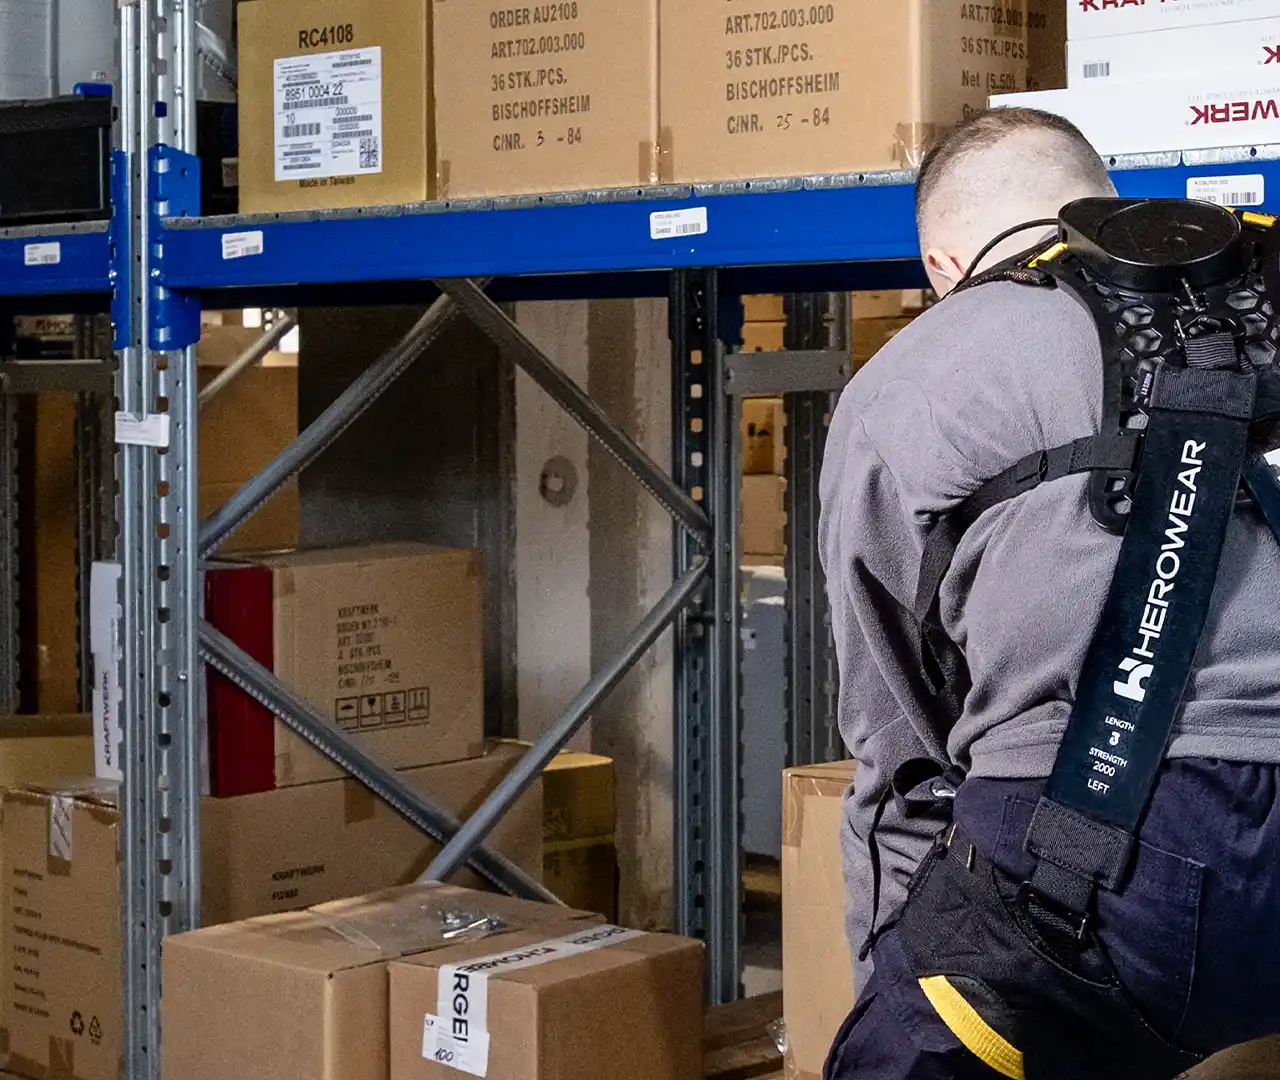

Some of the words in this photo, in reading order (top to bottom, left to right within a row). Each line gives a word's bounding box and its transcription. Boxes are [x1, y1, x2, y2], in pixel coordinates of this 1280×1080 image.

[489, 8, 531, 29] ORDER
[533, 2, 578, 24] AU2108
[725, 4, 835, 35] ART.702.003.000
[298, 24, 354, 48] RC4108
[491, 32, 585, 59] ART.702.003.000
[961, 37, 974, 54] 36
[726, 50, 742, 70] 36
[745, 43, 813, 67] STK./PCS.
[492, 73, 505, 91] 36
[508, 68, 568, 89] STK./PCS.
[726, 72, 840, 101] BISCHOFFSHEIM
[961, 70, 981, 88] Net
[285, 87, 306, 100] 8951
[332, 82, 344, 96] 22
[286, 112, 296, 124] 10
[492, 94, 590, 121] BISCHOFFSHEIM
[1132, 439, 1207, 658] HEROWEAR
[102, 668, 111, 766] KRAFTWERK
[1104, 716, 1135, 732] LENGTH
[1089, 747, 1128, 767] STRENGTH
[1093, 761, 1116, 777] 2000
[1087, 778, 1110, 794] LEFT
[434, 1047, 454, 1062] 100
